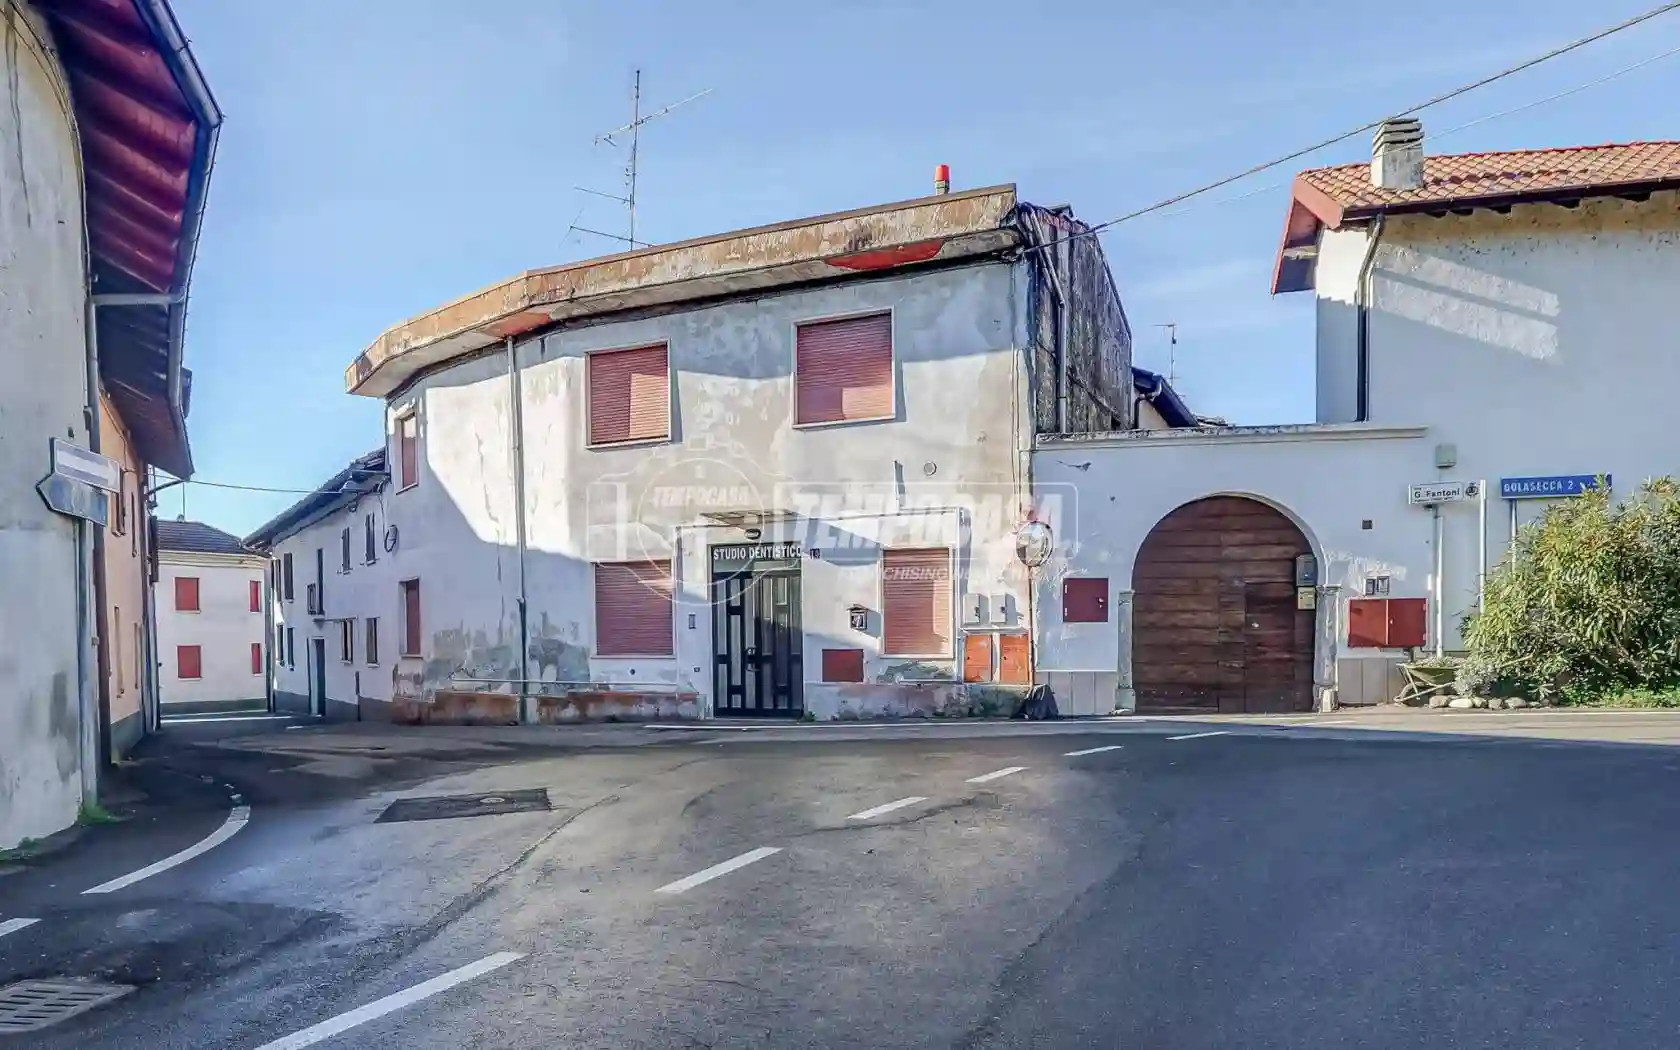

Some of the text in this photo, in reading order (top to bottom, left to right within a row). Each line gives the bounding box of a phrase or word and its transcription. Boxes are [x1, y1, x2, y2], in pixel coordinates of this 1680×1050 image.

[1426, 488, 1460, 498] Fantoni
[1503, 480, 1563, 493] GOLASECCA
[713, 544, 801, 560] STUDIO DENTISTICO
